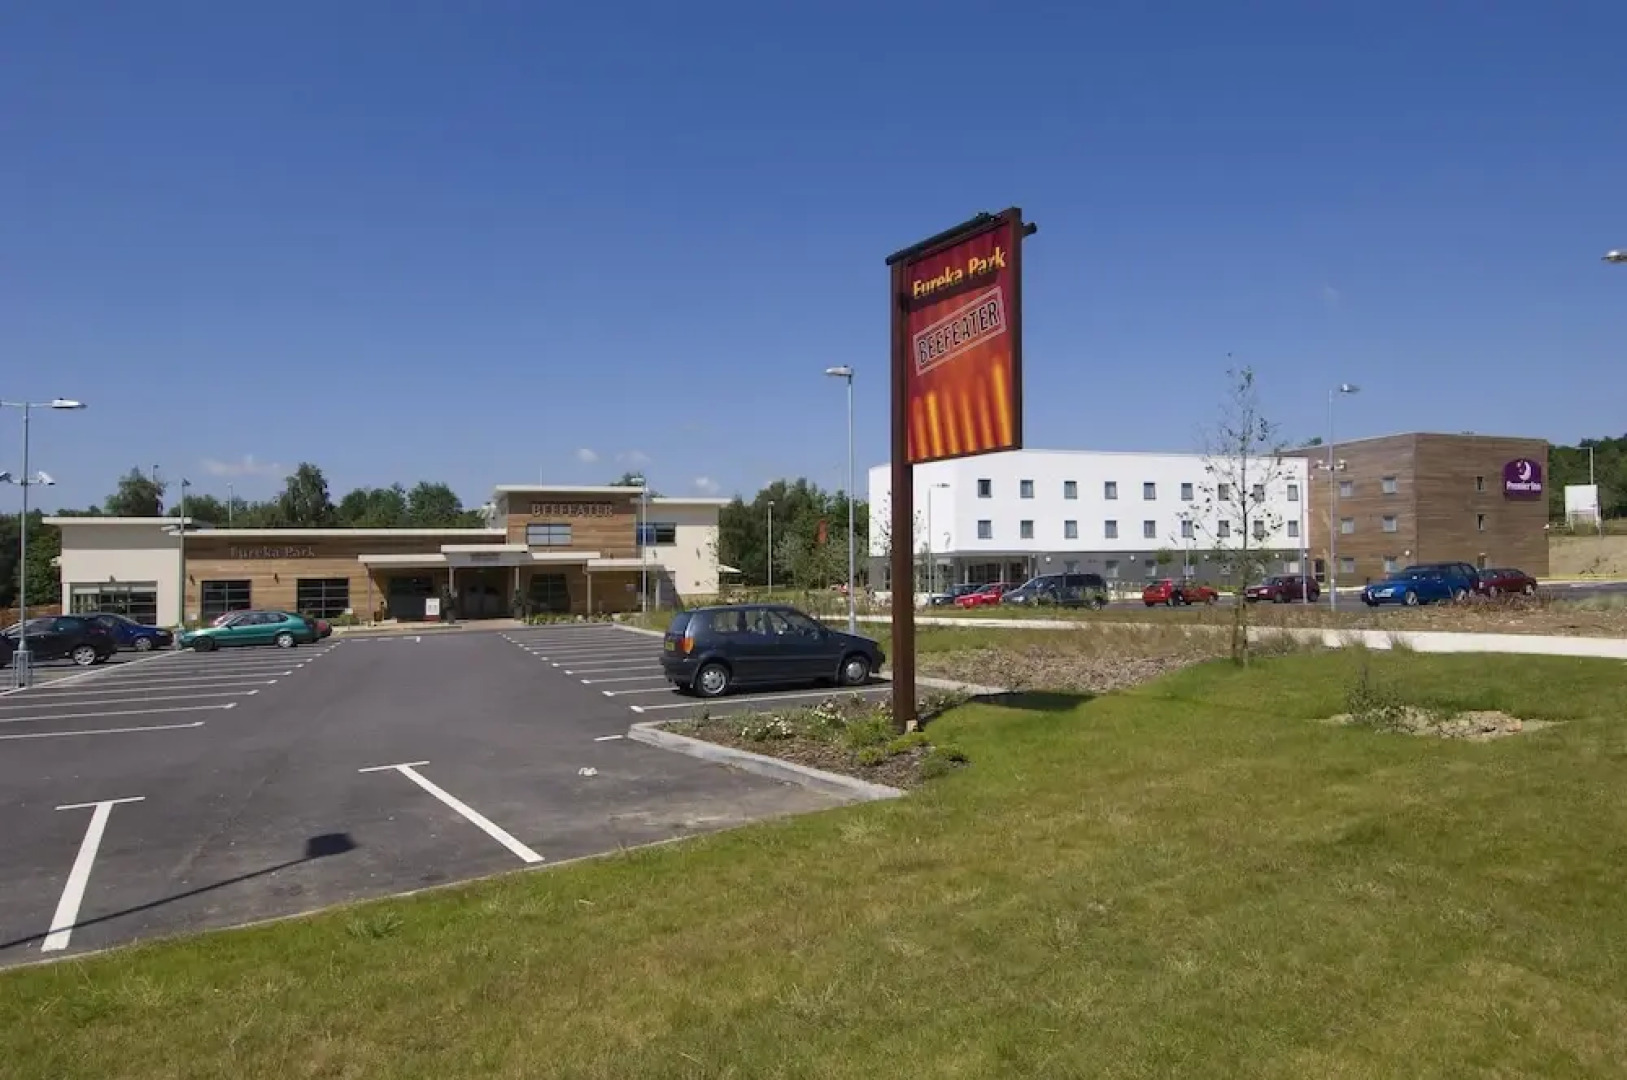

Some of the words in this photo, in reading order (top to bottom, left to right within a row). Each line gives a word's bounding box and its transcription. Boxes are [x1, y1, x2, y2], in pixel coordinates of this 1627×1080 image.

[913, 266, 963, 299] Eureka
[968, 246, 1006, 278] Park
[918, 300, 999, 365] BEEFEATER
[531, 502, 613, 517] BEEFEATER
[284, 545, 315, 559] Park
